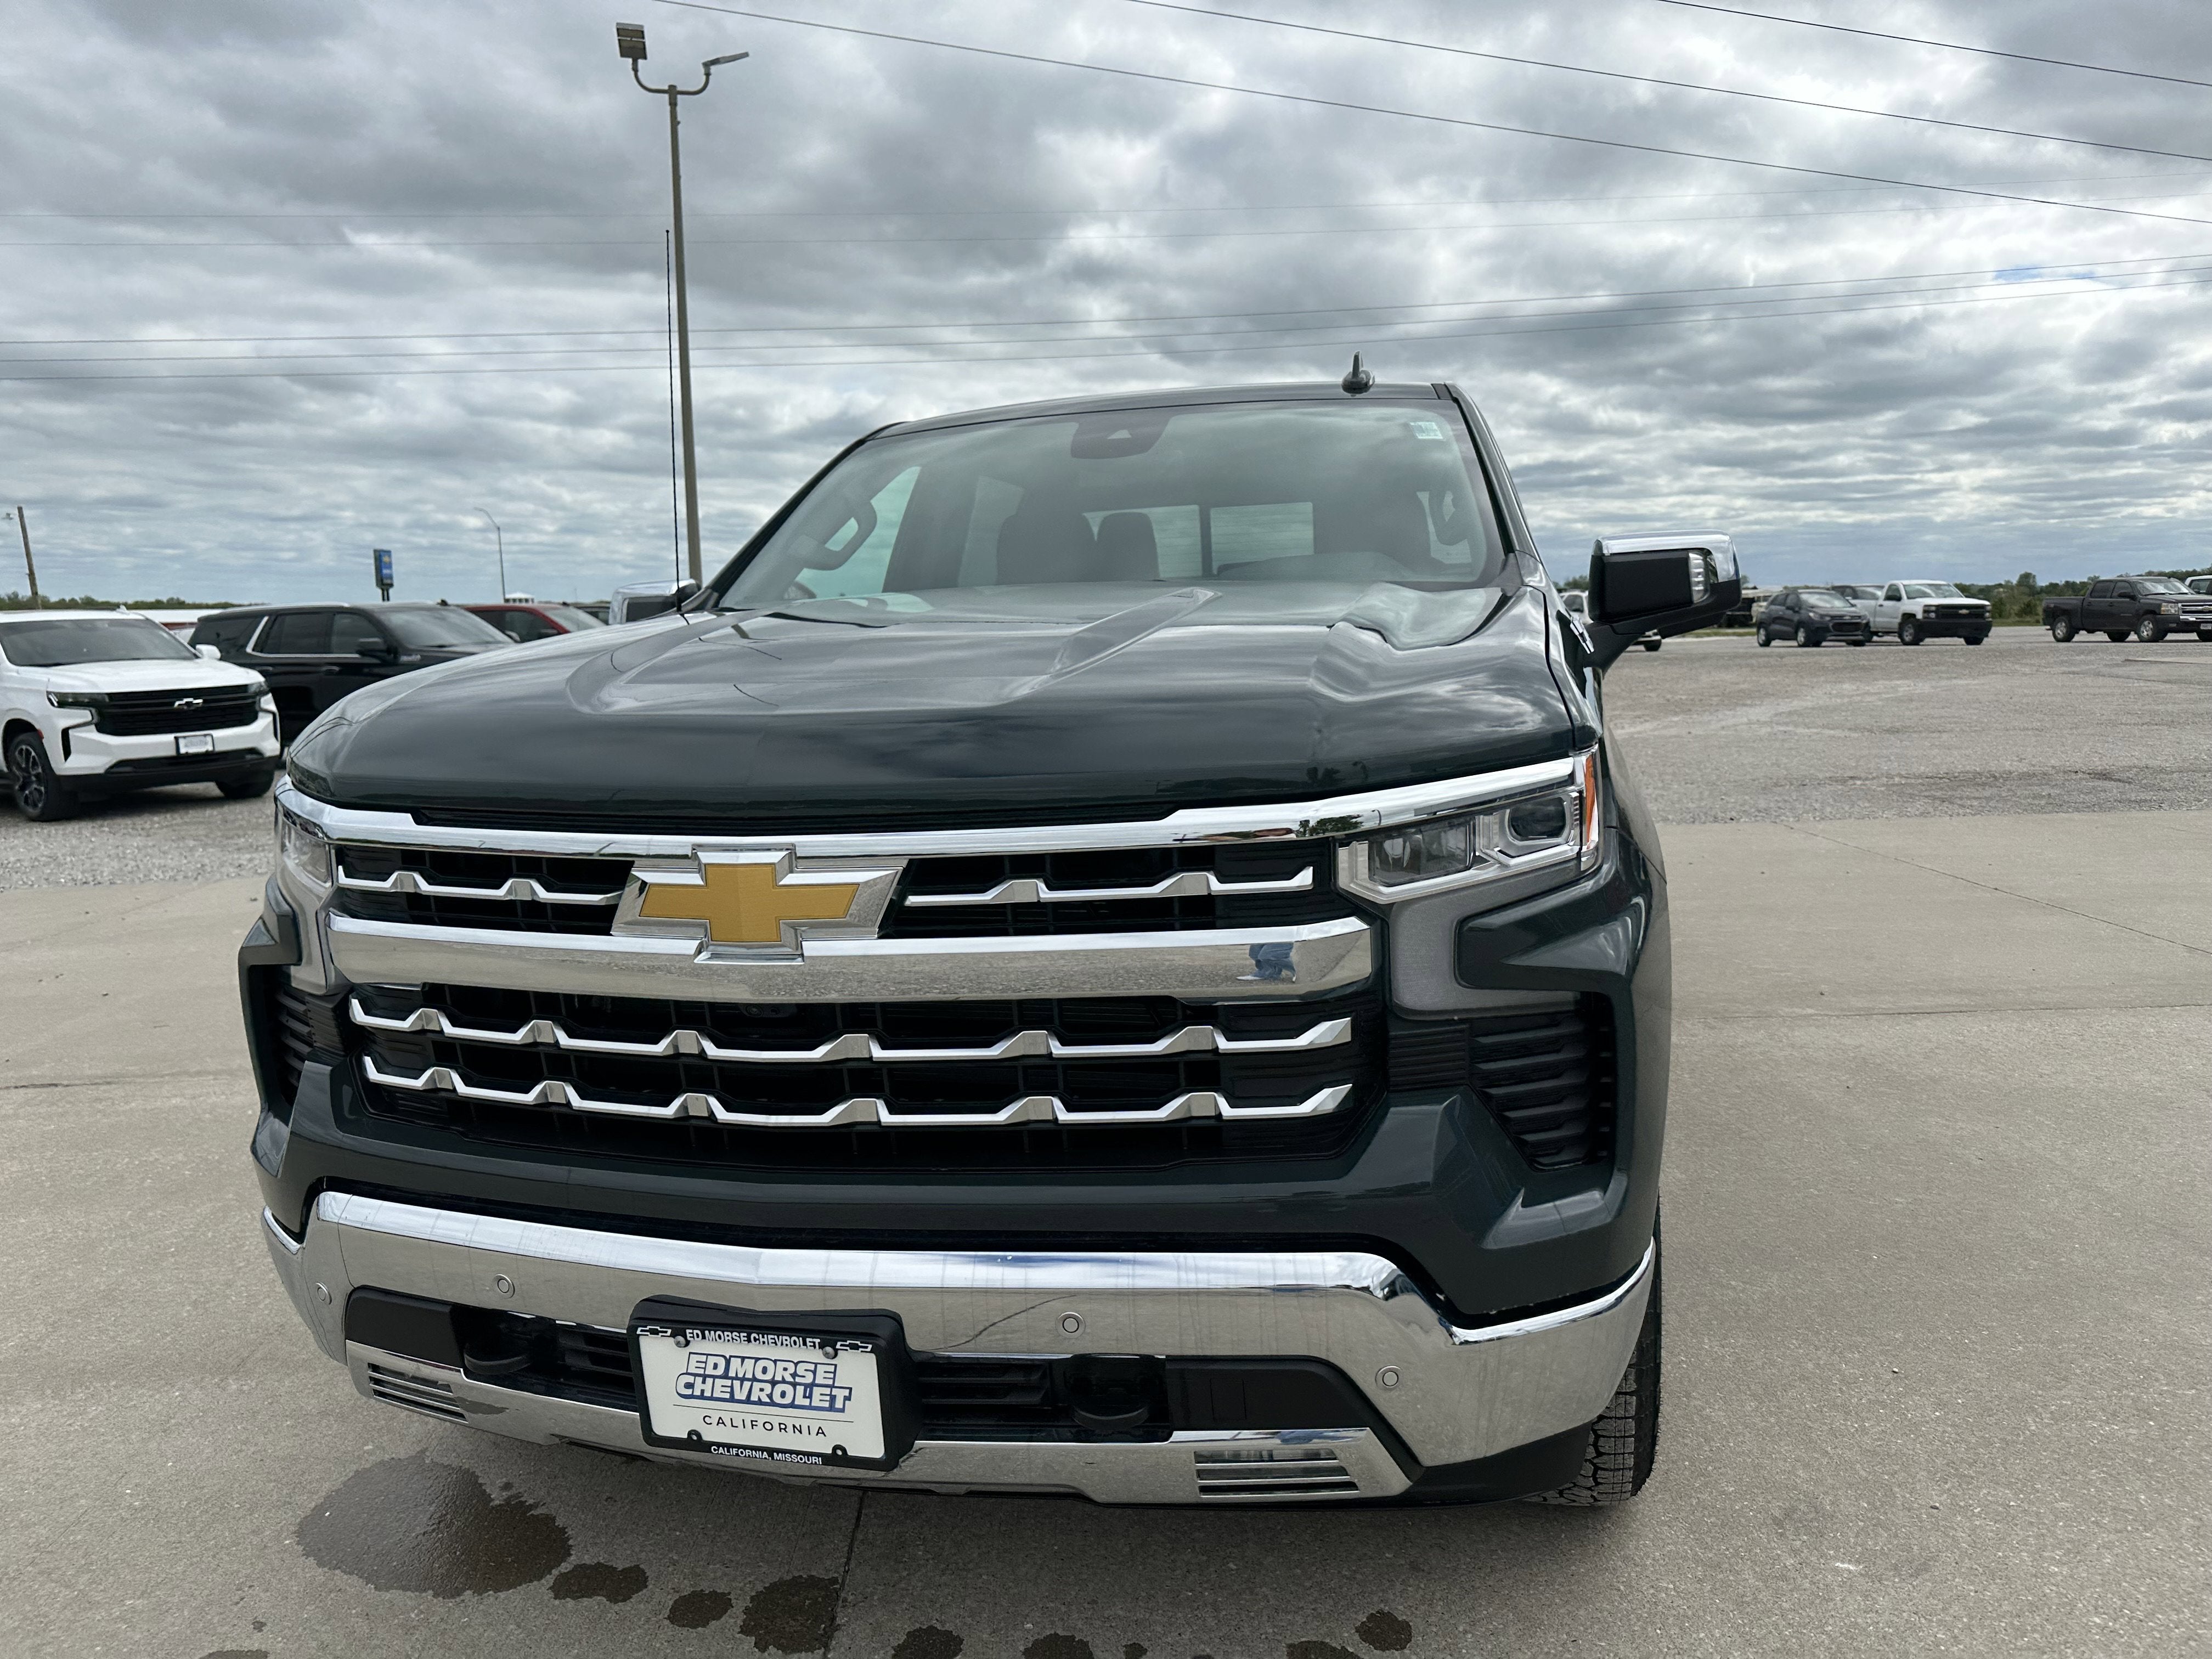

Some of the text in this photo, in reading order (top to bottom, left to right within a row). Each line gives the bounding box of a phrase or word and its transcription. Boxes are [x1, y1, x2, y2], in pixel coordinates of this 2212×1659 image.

[686, 1329, 821, 1350] ED MORSE CHEVROLET
[687, 1353, 836, 1386] ED MORSE
[675, 1373, 851, 1410] CHEVROLET
[703, 1415, 827, 1437] CALIFORNIA
[711, 1446, 822, 1465] CALIFORNIA, MISSOURI
